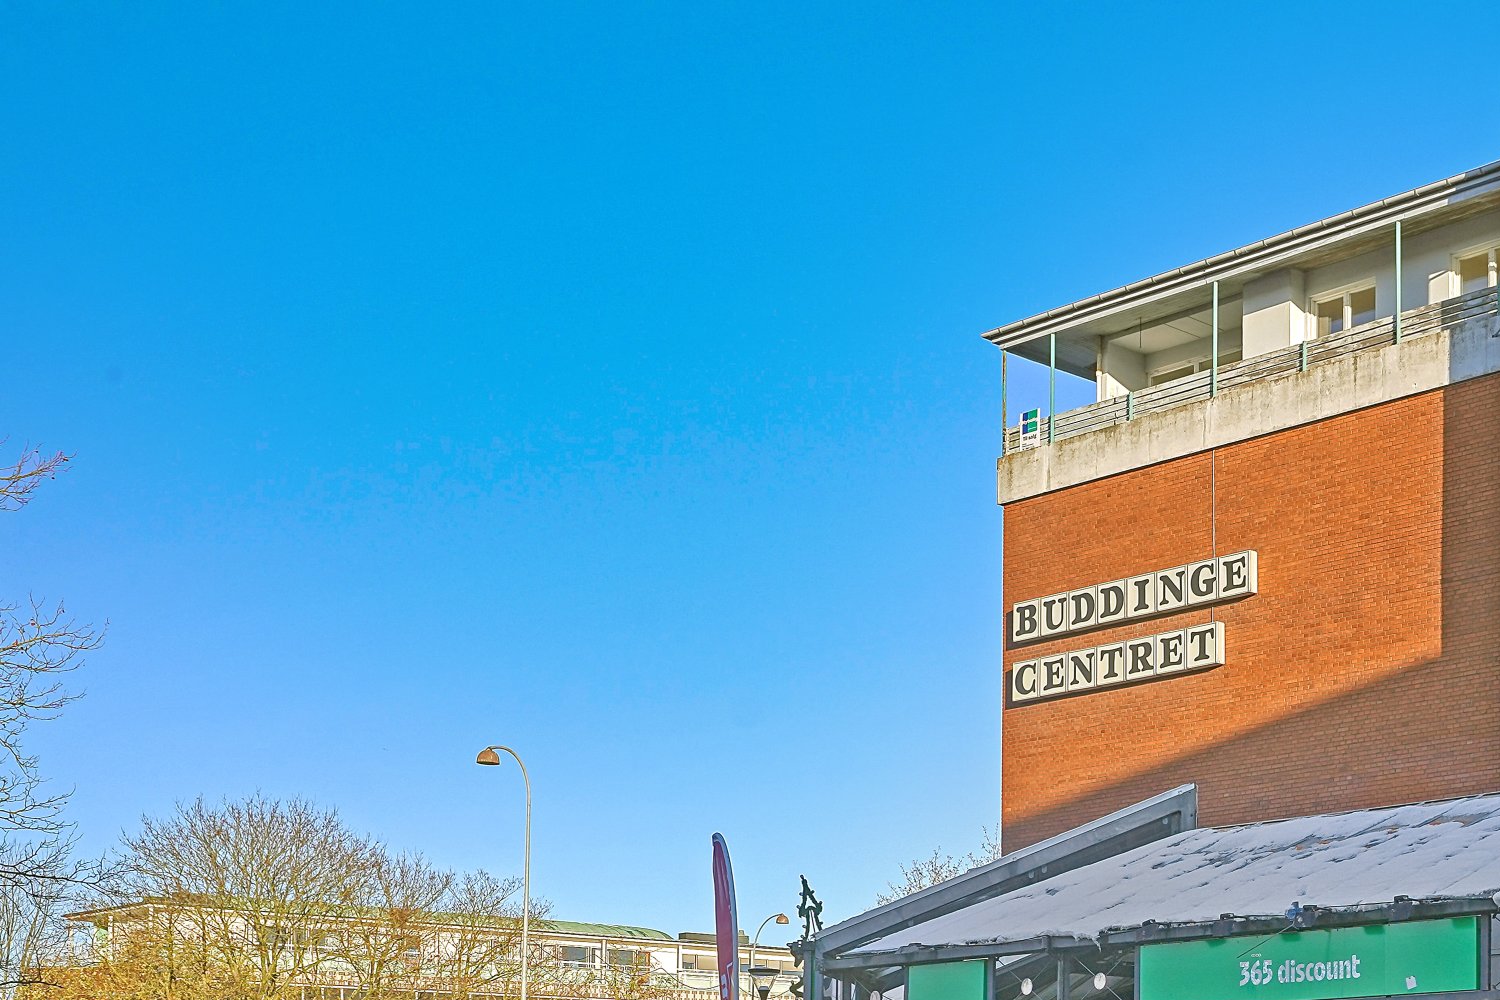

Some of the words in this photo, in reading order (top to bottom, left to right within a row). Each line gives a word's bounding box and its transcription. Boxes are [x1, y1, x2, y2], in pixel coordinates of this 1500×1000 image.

[1015, 556, 1246, 637] BUDDINGE
[1014, 628, 1214, 695] CENTRET
[1239, 960, 1273, 986] 365
[1278, 954, 1361, 983] discount
